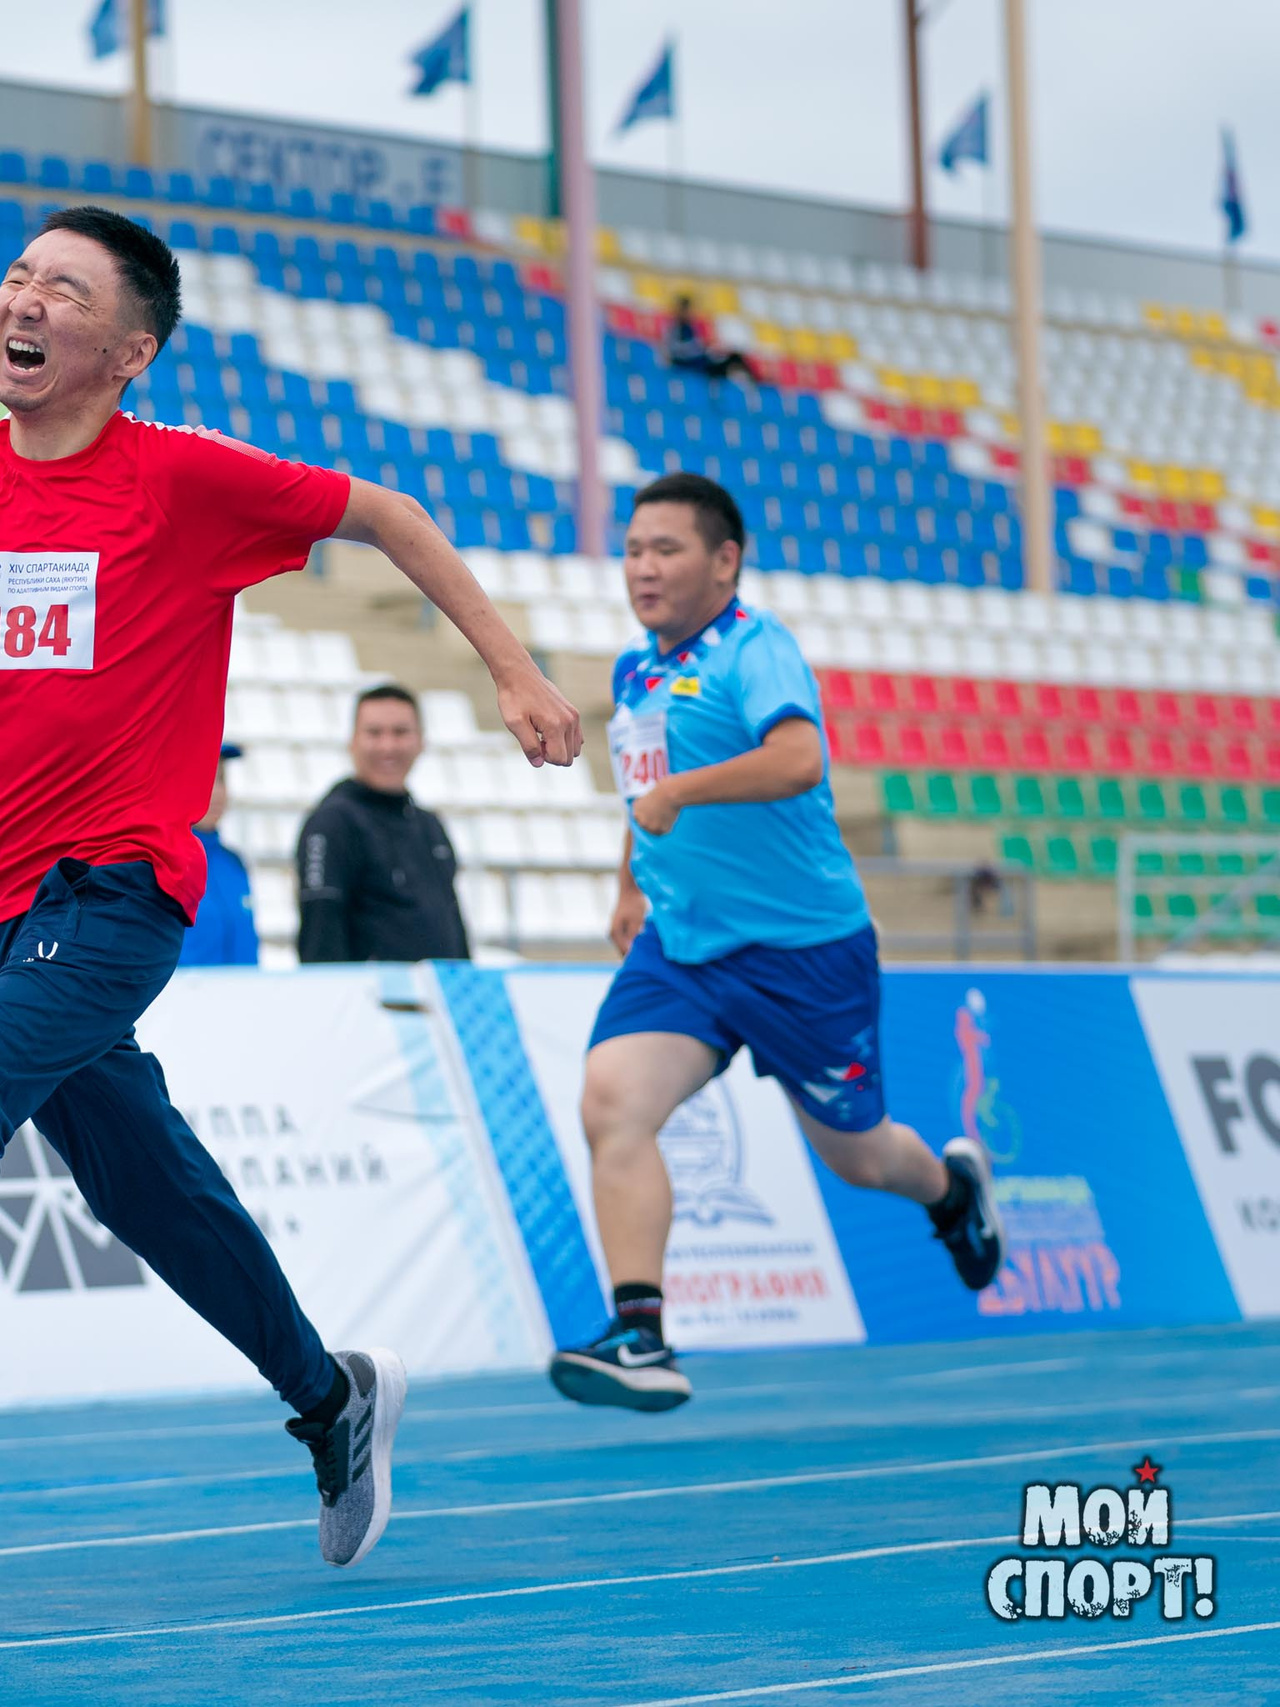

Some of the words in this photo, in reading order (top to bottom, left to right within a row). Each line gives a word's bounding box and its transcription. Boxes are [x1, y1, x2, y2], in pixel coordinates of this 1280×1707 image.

[9, 563, 25, 574] XIV
[25, 562, 90, 574] СПАРТАКИАДА
[8, 577, 45, 586] РЕСПУБЛИКИ
[46, 576, 60, 584] САХА
[61, 575, 87, 584] (ЯКУТИЯ)
